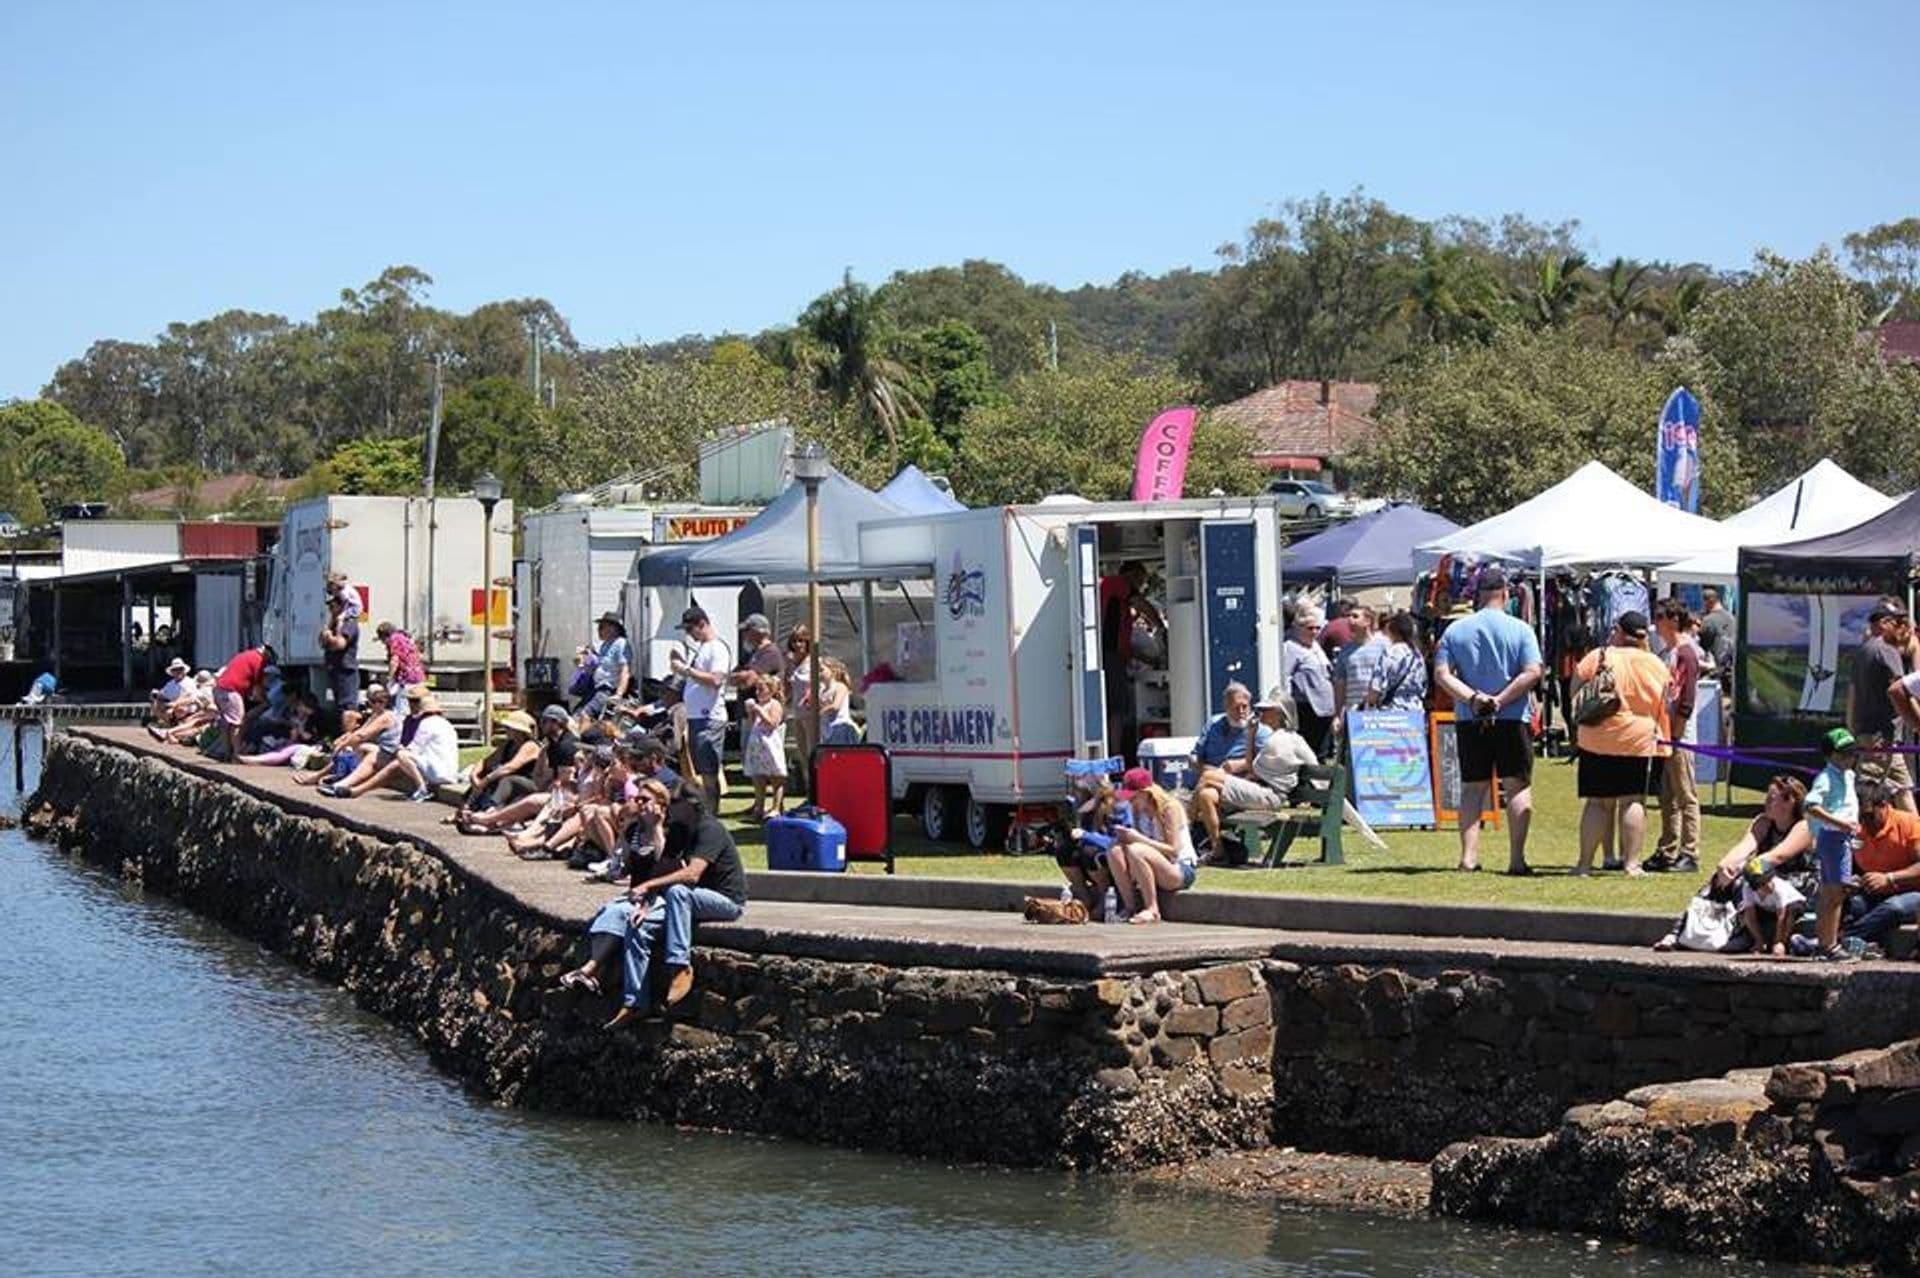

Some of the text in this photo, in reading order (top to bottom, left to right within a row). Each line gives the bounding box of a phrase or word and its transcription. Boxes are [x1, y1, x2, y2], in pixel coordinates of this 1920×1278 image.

[682, 519, 728, 536] PLUTO
[881, 708, 908, 744] ICE
[911, 708, 995, 745] CREAMERY
